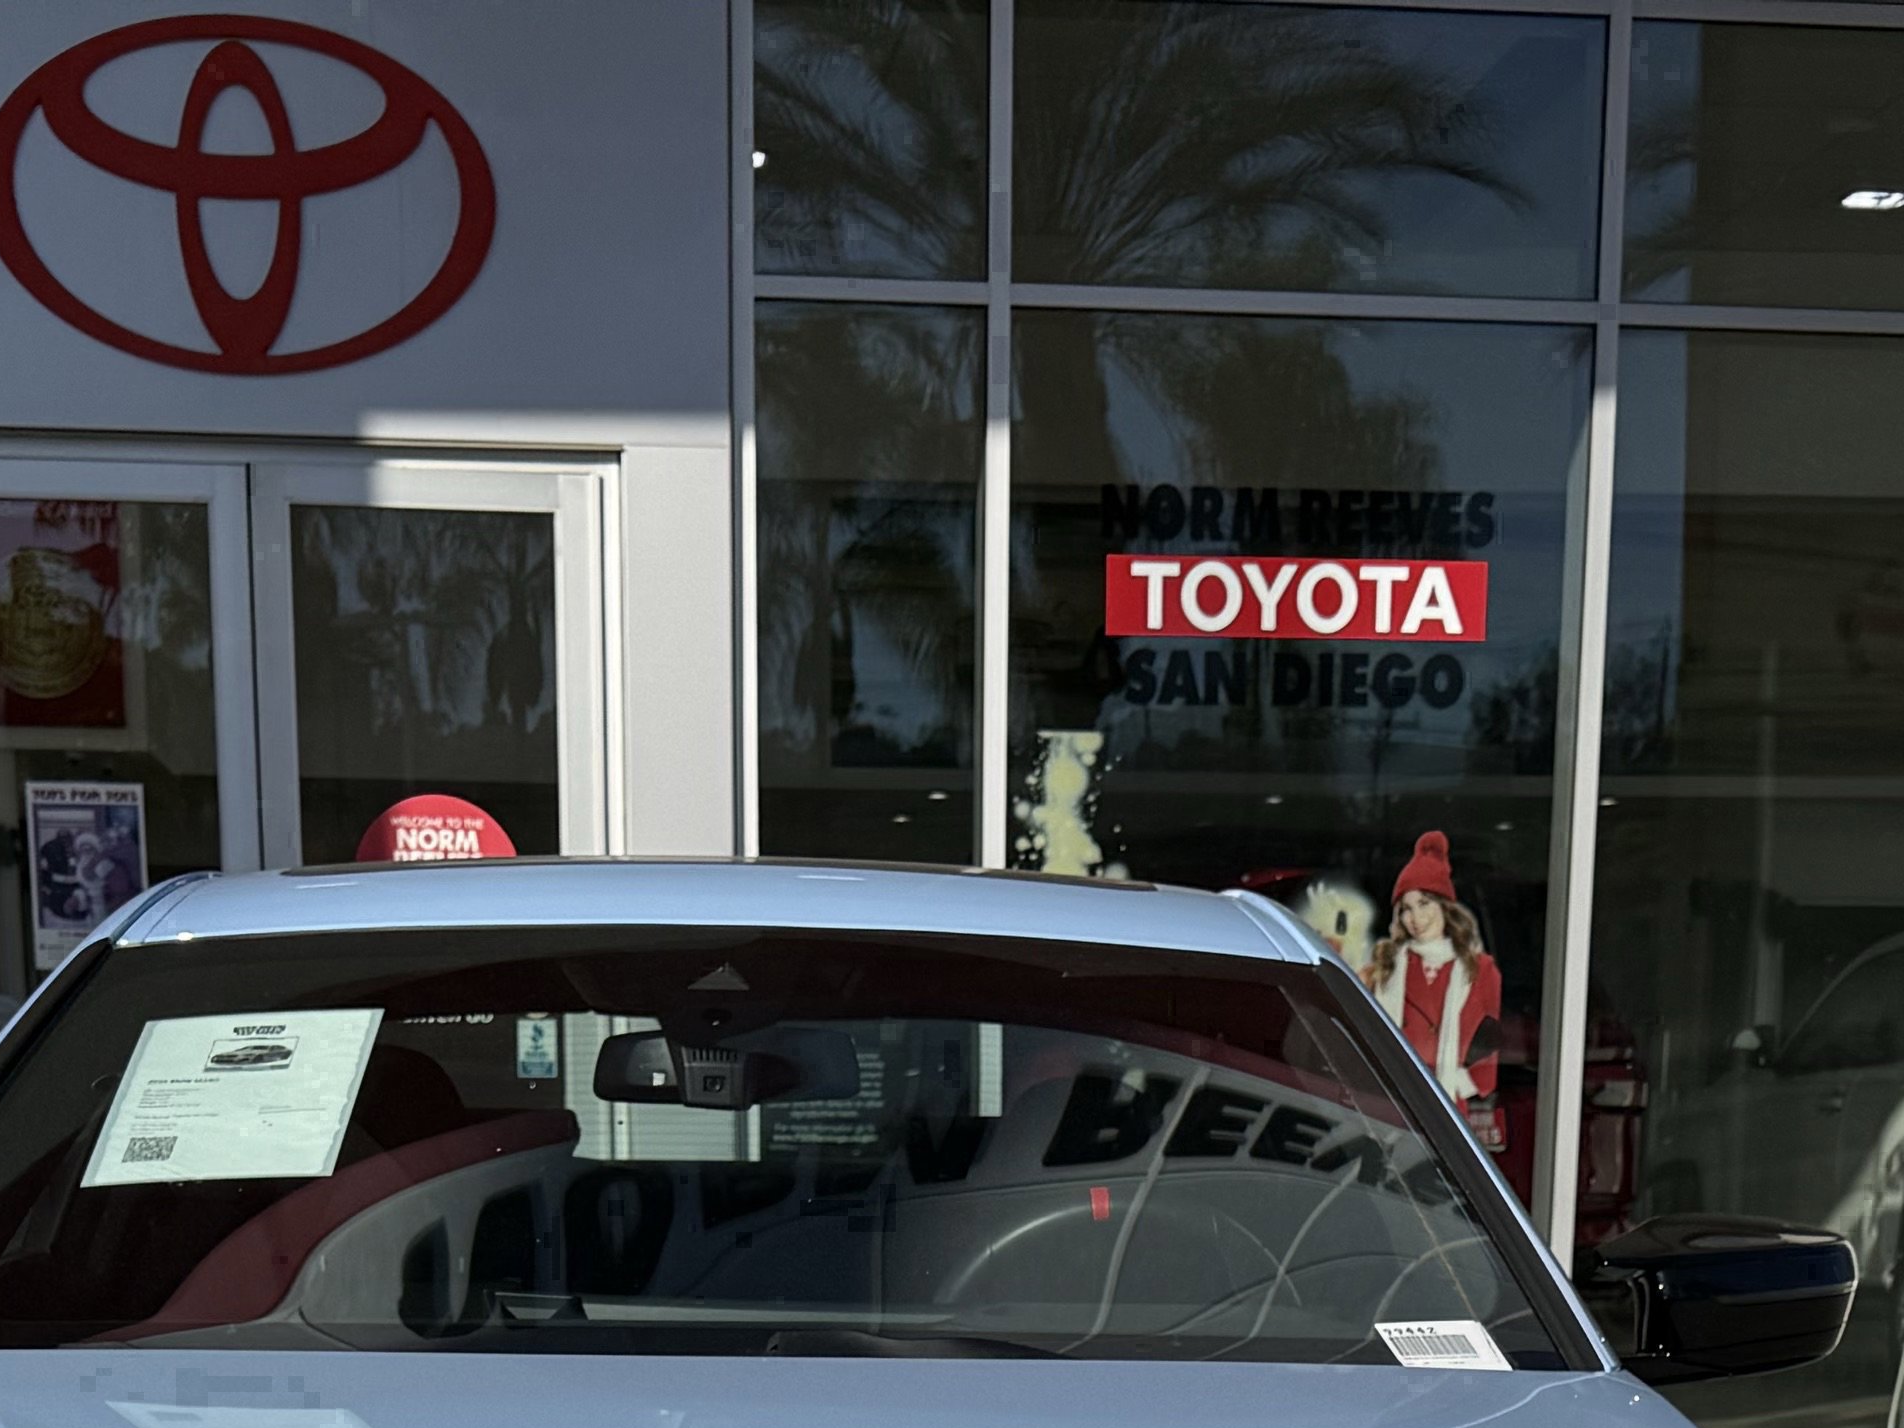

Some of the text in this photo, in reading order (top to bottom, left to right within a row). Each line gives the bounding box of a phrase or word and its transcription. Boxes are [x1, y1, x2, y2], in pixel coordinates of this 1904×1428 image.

[1101, 483, 1496, 549] NORM REEVES
[1130, 560, 1464, 634] TOYOTA
[1125, 648, 1465, 710] SAN DIEGO
[390, 815, 485, 830] WELCOME TO THE
[396, 828, 480, 853] NORM
